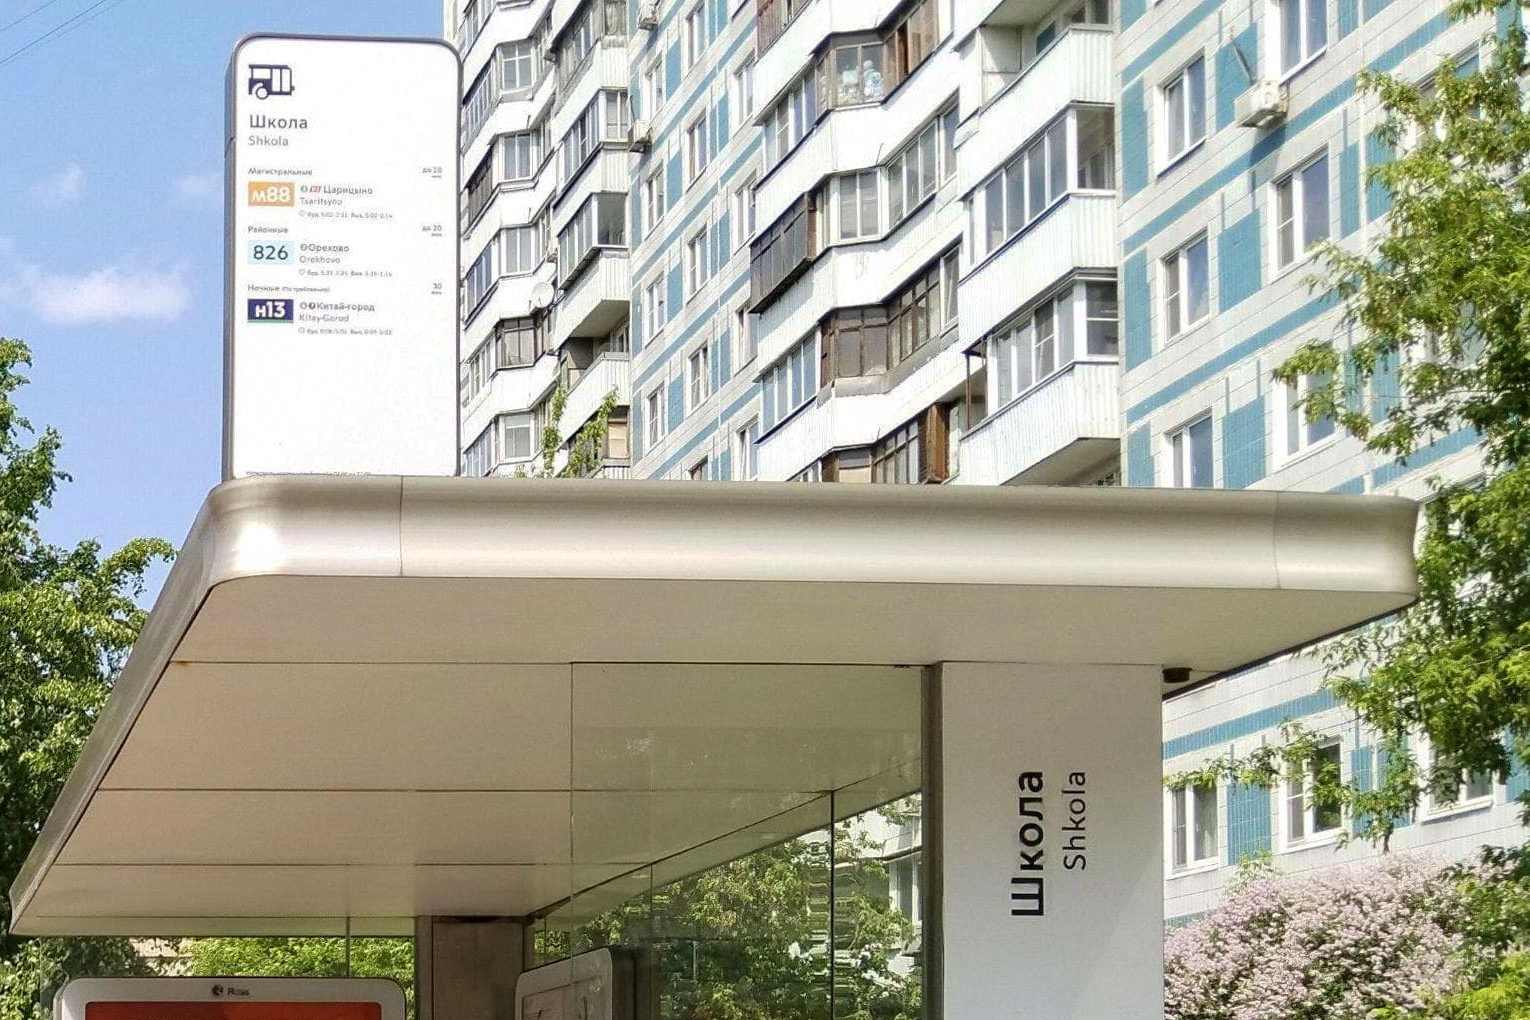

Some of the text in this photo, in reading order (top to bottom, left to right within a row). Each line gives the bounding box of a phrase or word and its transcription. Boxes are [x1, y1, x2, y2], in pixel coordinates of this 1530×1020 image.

[249, 114, 308, 129] Школа
[248, 135, 289, 147] Shkola
[252, 186, 291, 202] м88
[323, 184, 373, 195] Царицыно
[300, 197, 343, 206] Tsaritsyno
[253, 244, 289, 260] 826
[1061, 771, 1086, 870] Shkola
[1011, 771, 1044, 916] Школа
